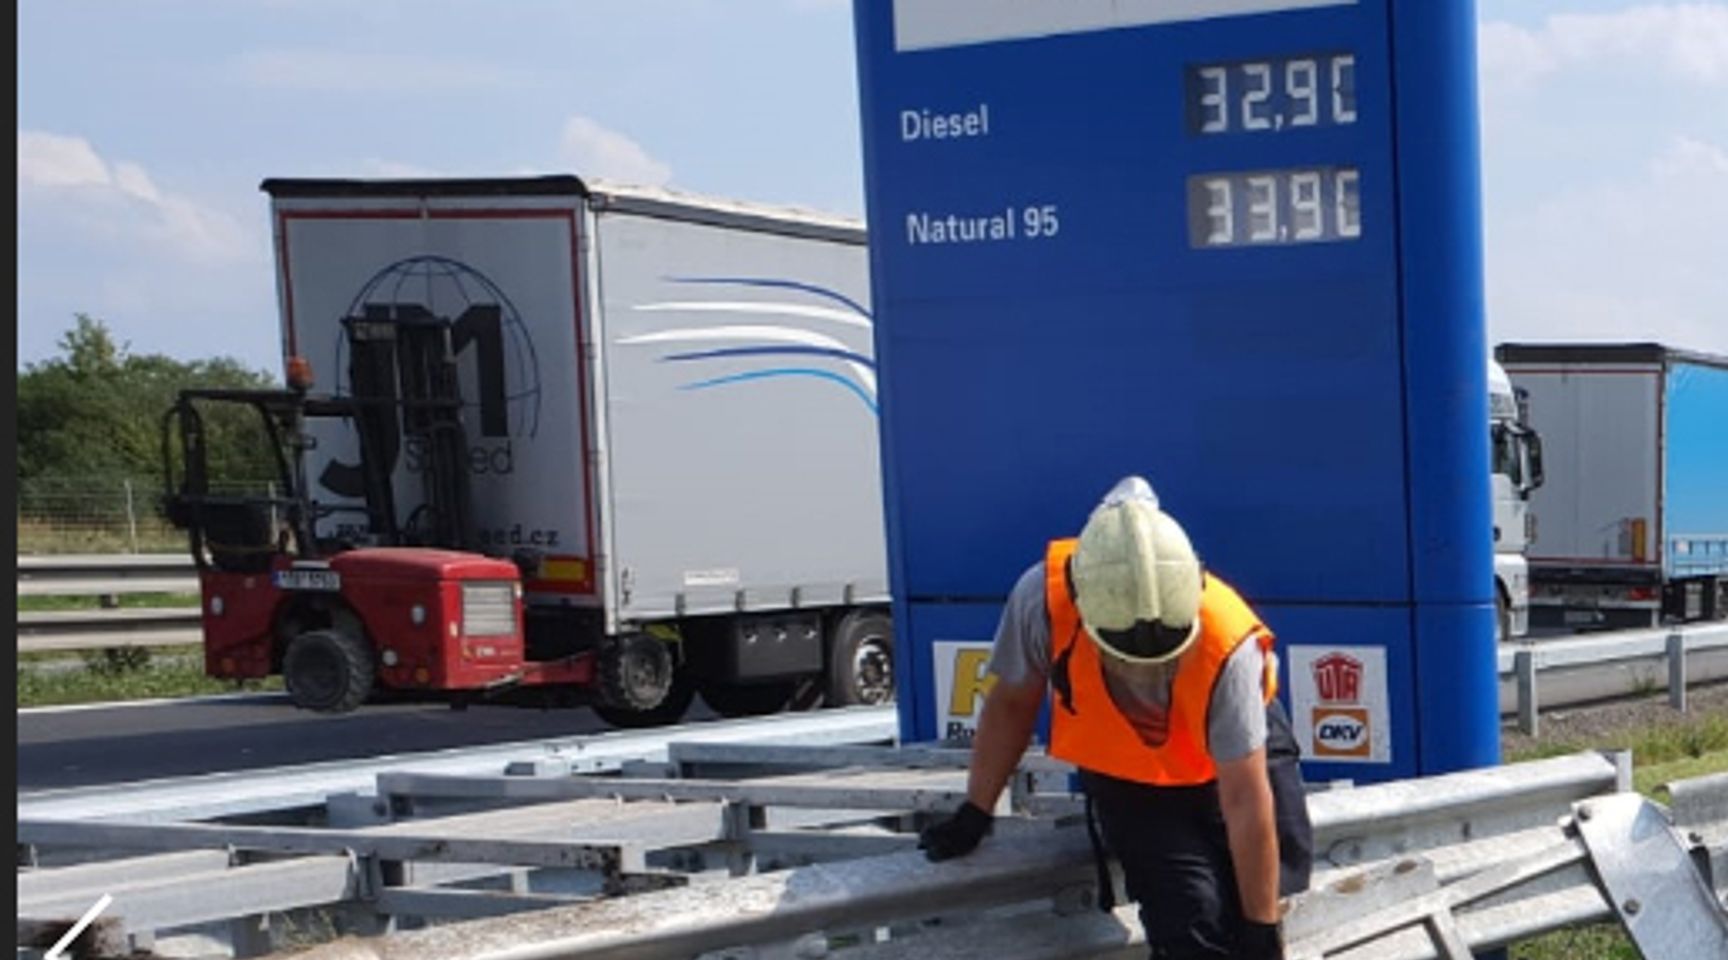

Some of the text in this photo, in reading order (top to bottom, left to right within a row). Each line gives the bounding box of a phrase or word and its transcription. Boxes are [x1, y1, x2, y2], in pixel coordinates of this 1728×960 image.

[901, 104, 988, 141] Diesel
[906, 204, 1058, 244] Natural 95
[1319, 723, 1364, 741] DKV
